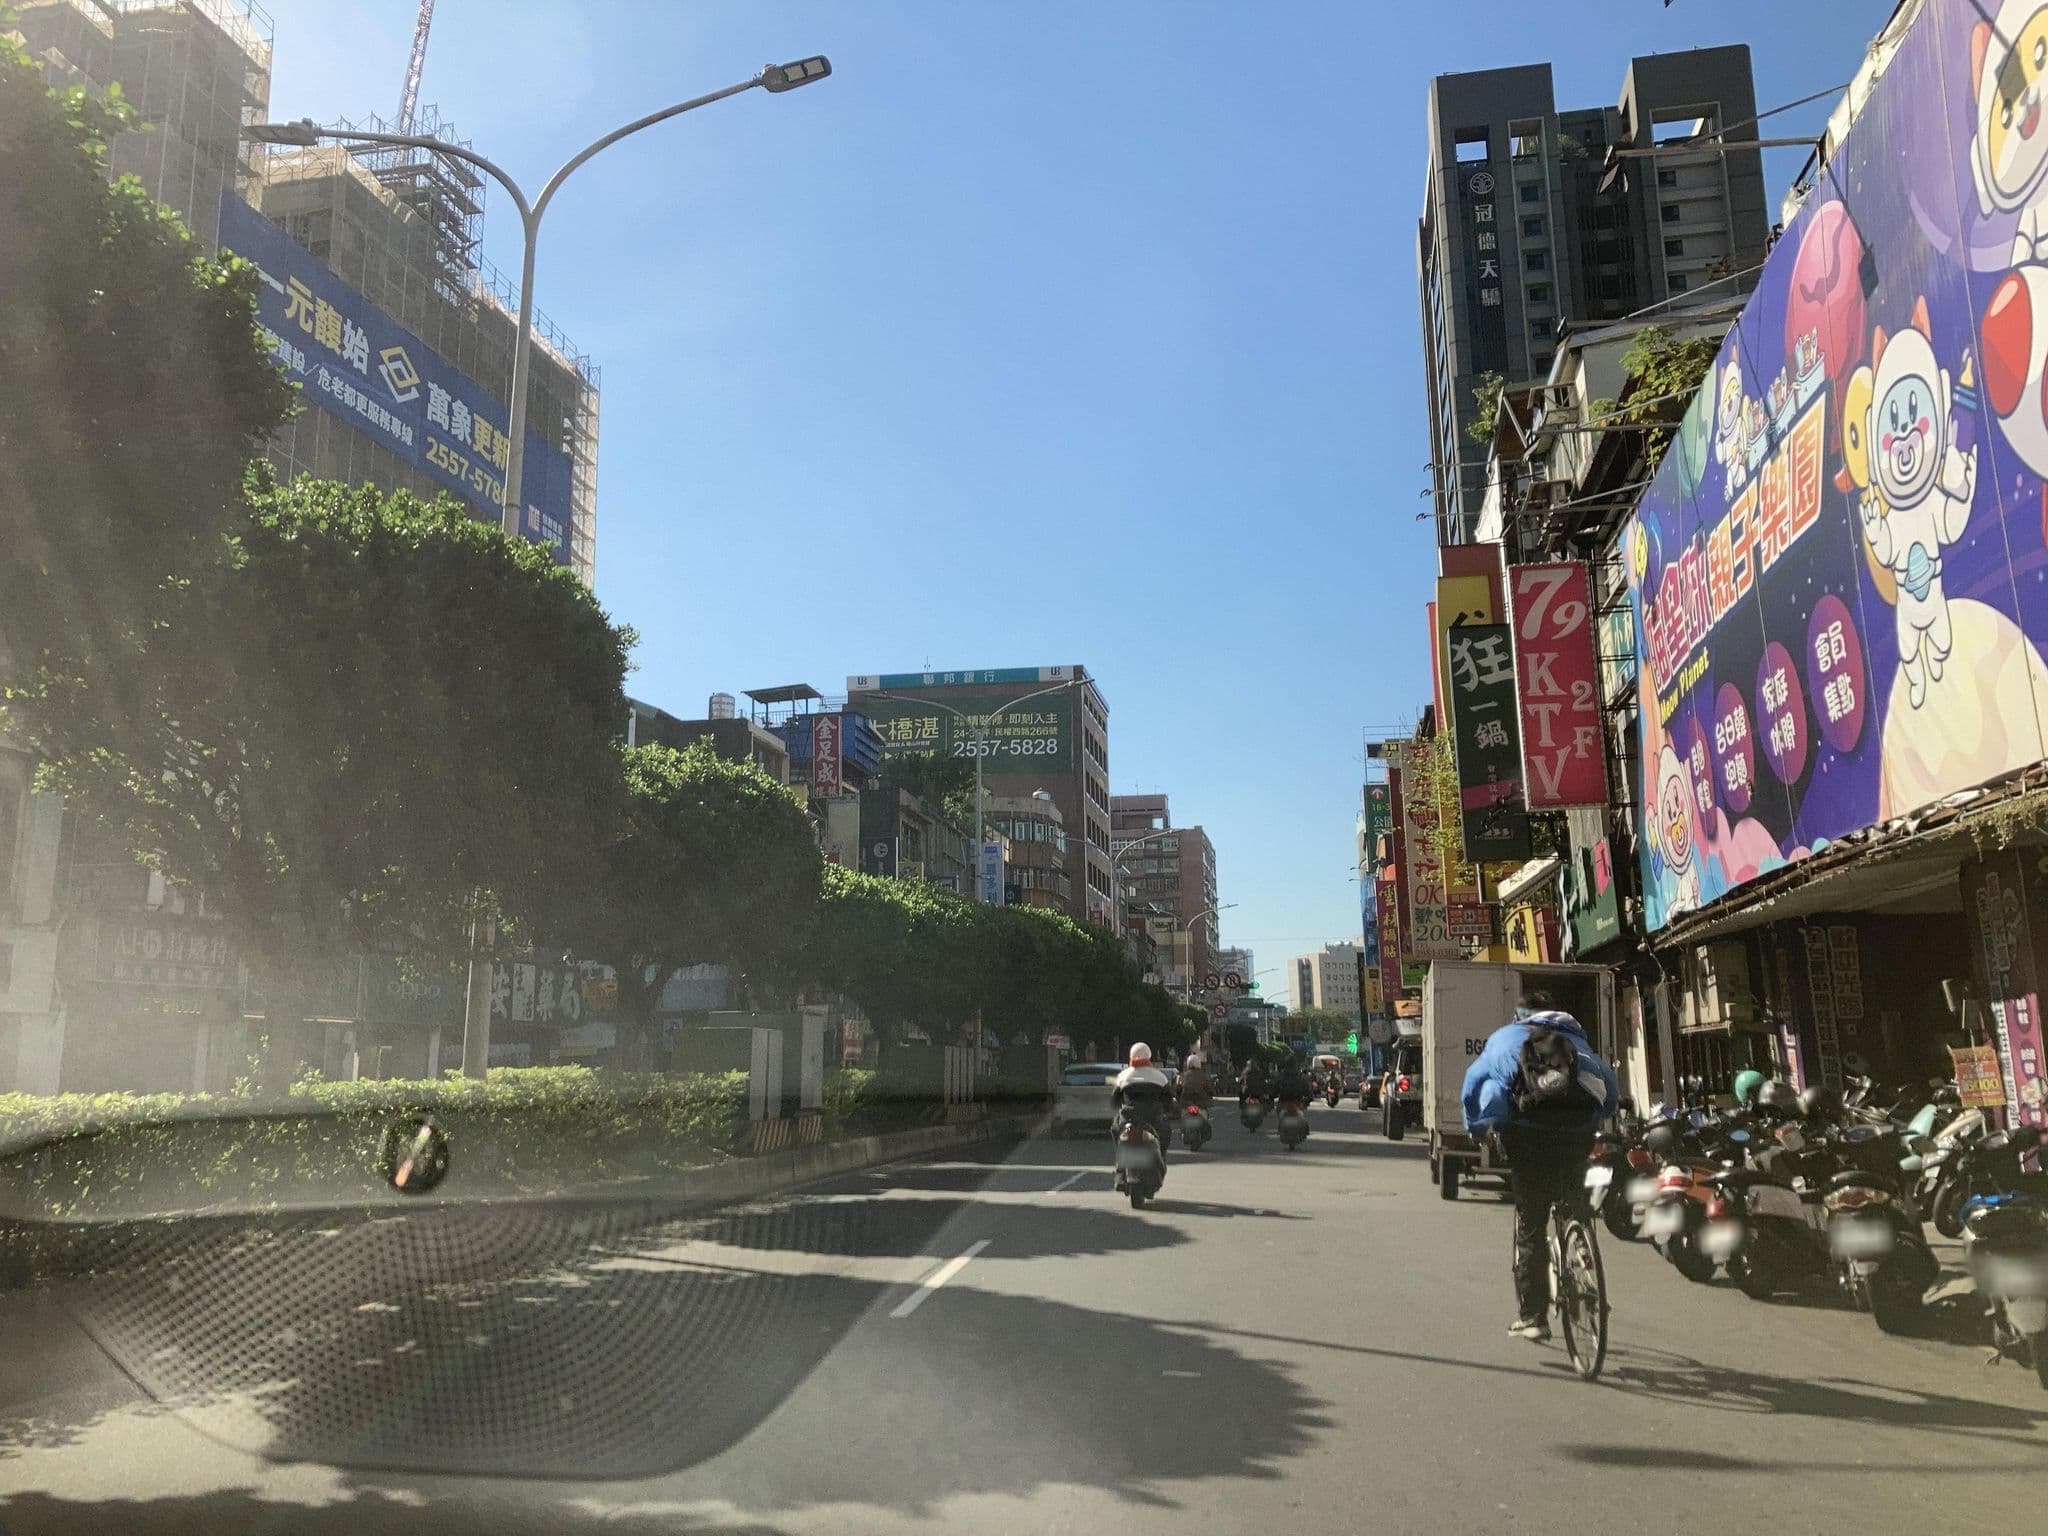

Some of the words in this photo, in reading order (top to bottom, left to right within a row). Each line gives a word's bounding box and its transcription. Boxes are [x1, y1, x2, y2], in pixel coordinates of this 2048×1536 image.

[427, 381, 511, 471] 萬象更新
[426, 437, 506, 507] 2557-578
[1517, 567, 1587, 640] 79
[1815, 620, 1848, 673] 會員
[1450, 633, 1515, 750] 狂一鍋
[1571, 679, 1599, 759] 2F
[1660, 687, 1680, 723] Meow
[1679, 646, 1710, 697] Planet
[1762, 667, 1789, 714] 家庭
[1824, 672, 1856, 724] 集點
[953, 738, 1058, 758] 2557-5828
[1524, 652, 1573, 800] KTV
[1770, 712, 1796, 757] 休閒
[1414, 884, 1445, 906] OK
